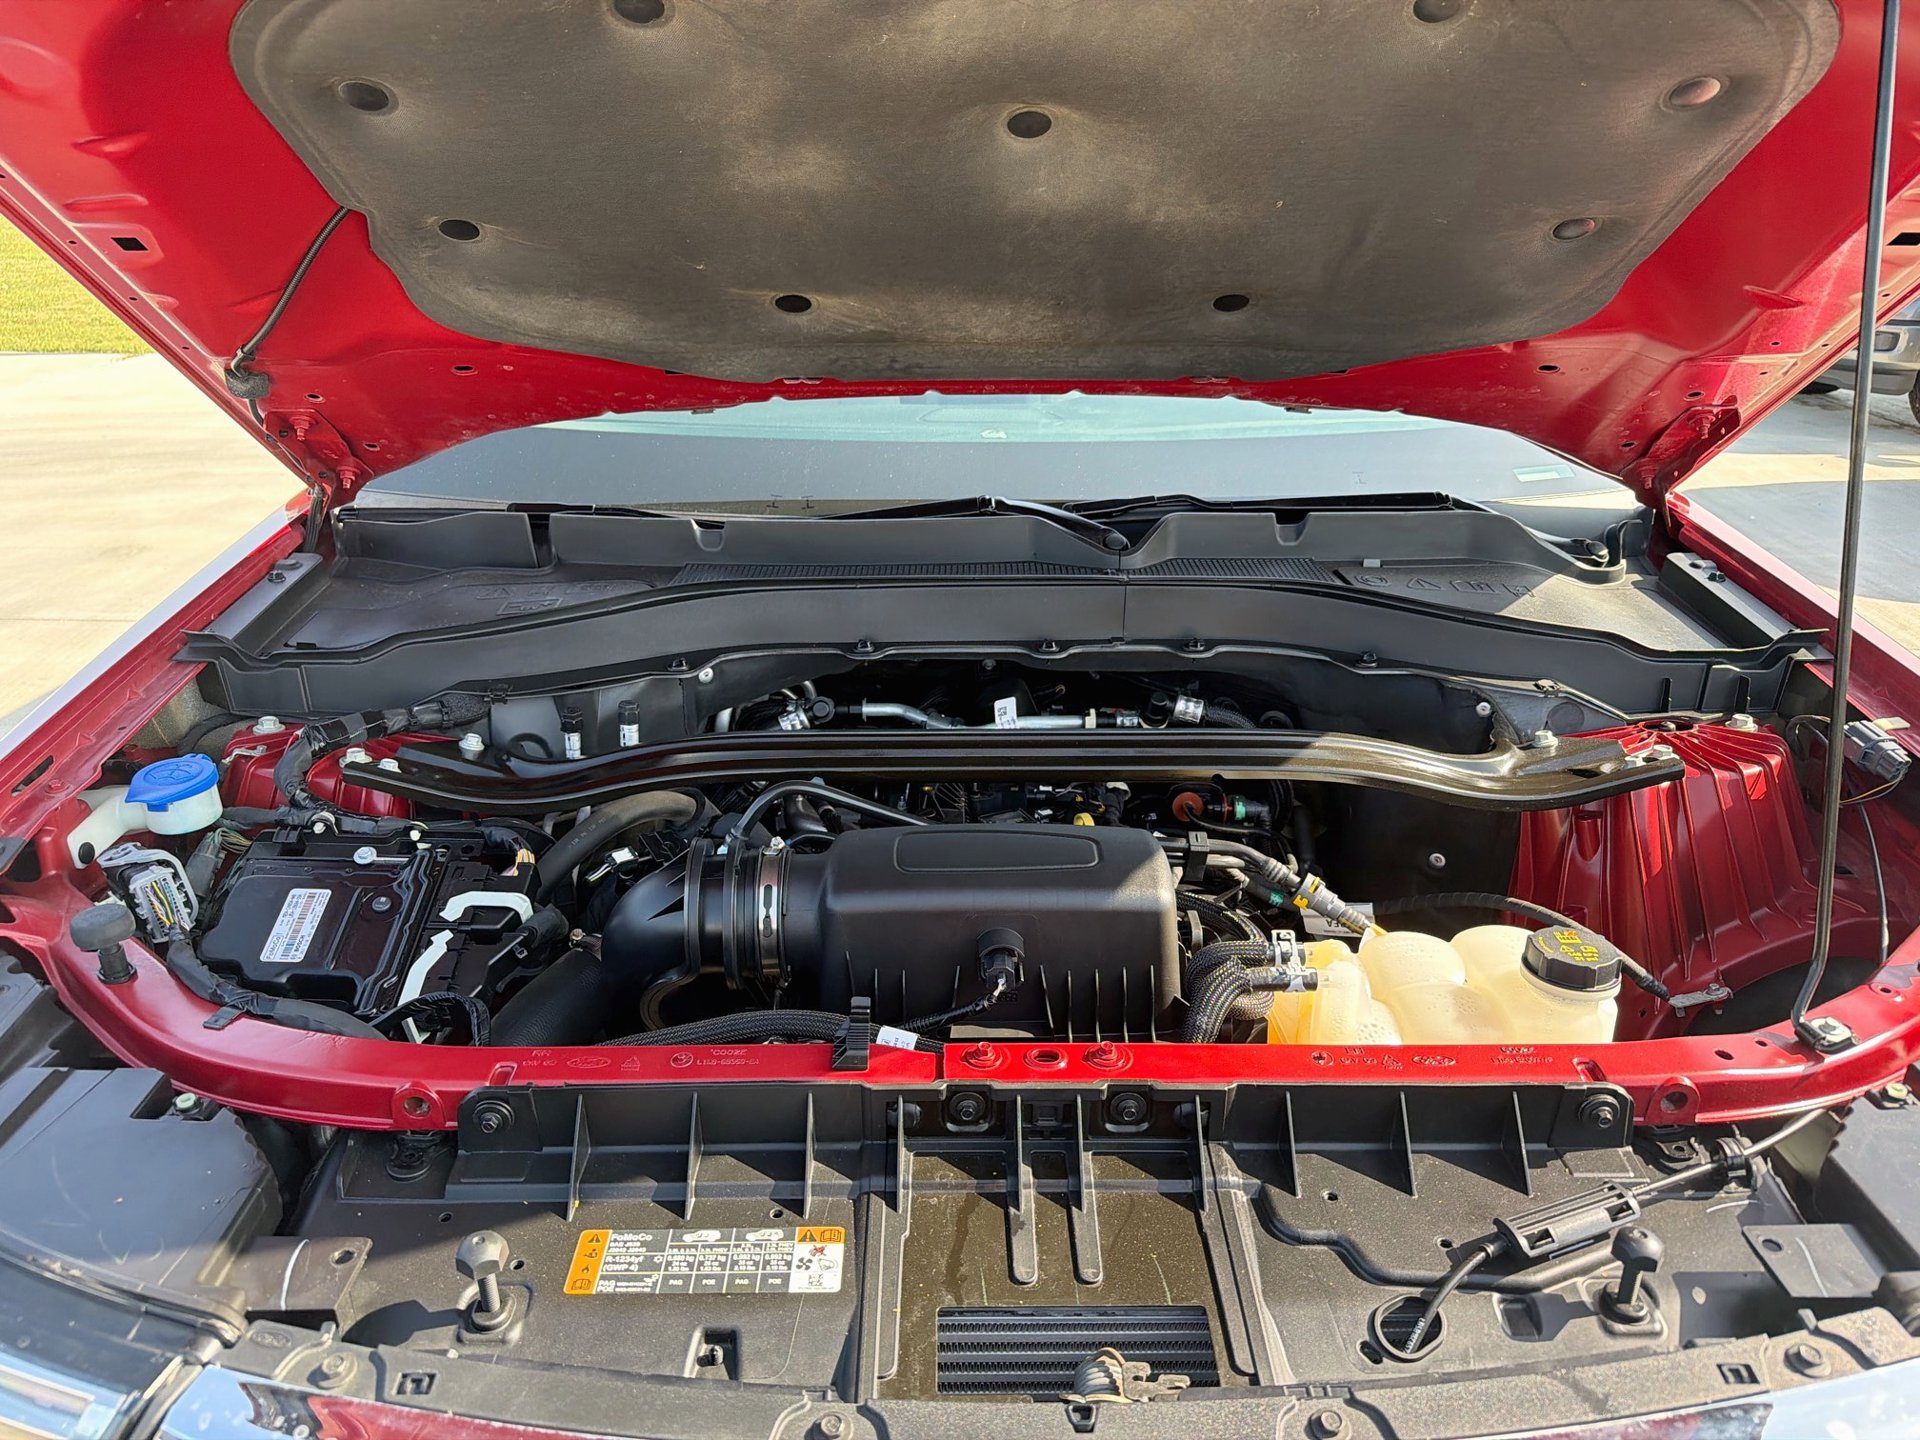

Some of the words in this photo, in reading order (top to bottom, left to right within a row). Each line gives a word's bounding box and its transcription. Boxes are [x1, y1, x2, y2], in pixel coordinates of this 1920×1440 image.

[611, 1233, 652, 1241] FoMoCo
[606, 1255, 644, 1264] R-1234yf
[603, 1264, 628, 1272] (GWP
[629, 1264, 638, 1272] 4)
